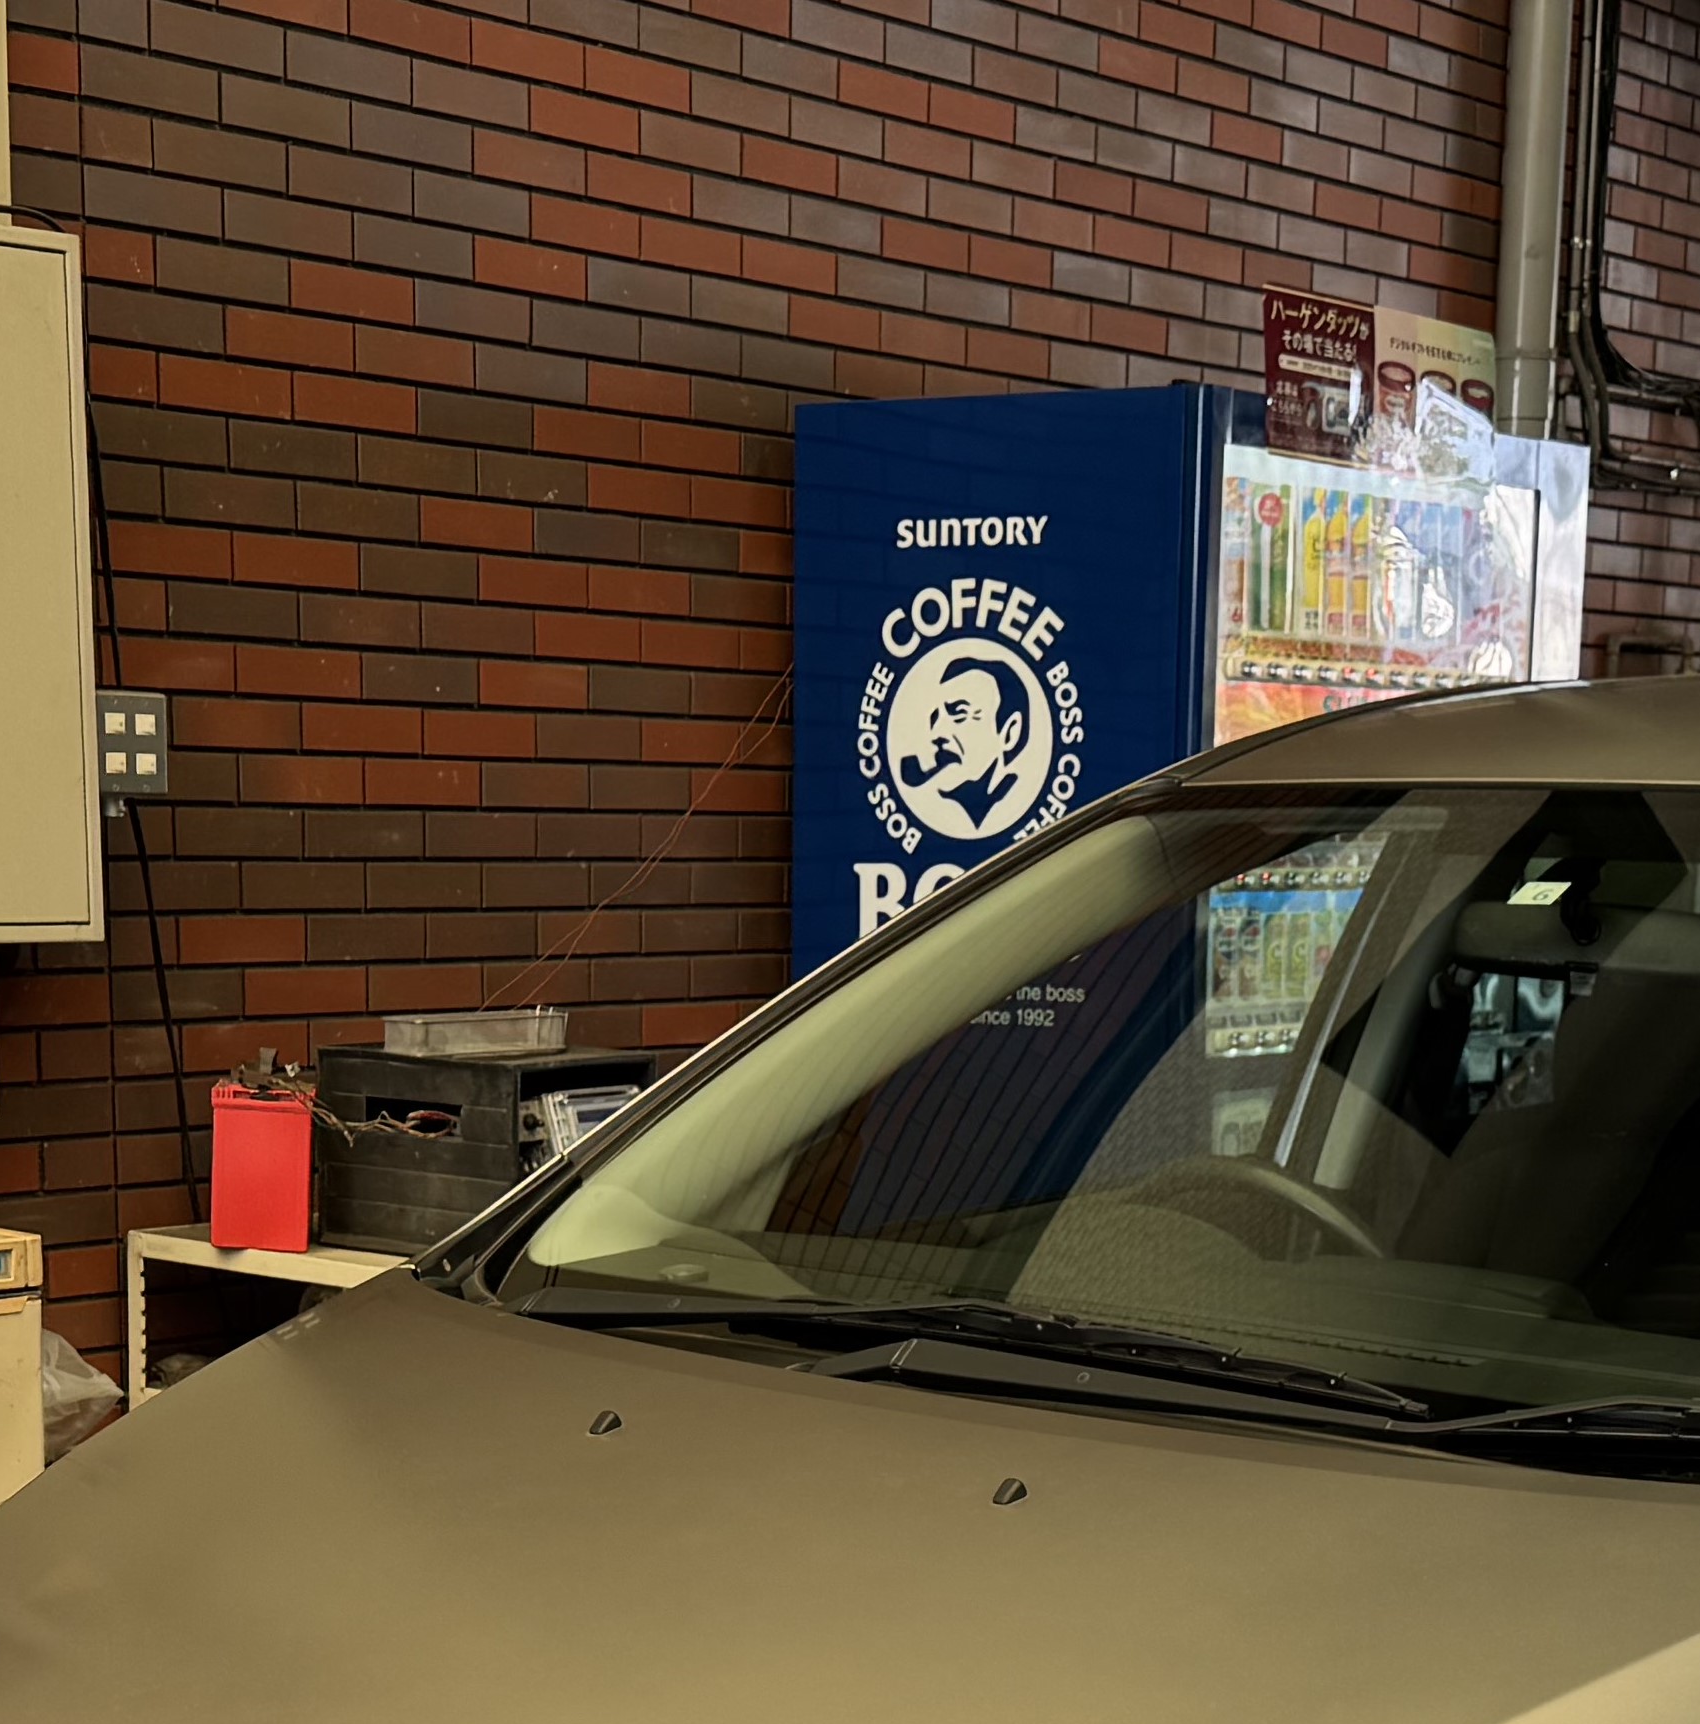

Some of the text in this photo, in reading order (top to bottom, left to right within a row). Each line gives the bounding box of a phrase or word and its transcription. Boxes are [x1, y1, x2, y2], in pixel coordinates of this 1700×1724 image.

[896, 514, 1049, 549] SUNTORY
[881, 577, 1065, 662] COFFEE
[1045, 660, 1085, 745] BOSS
[856, 661, 923, 855] BOSS COFFEE
[1016, 1007, 1056, 1027] 1992
[1045, 983, 1087, 1003] boss
